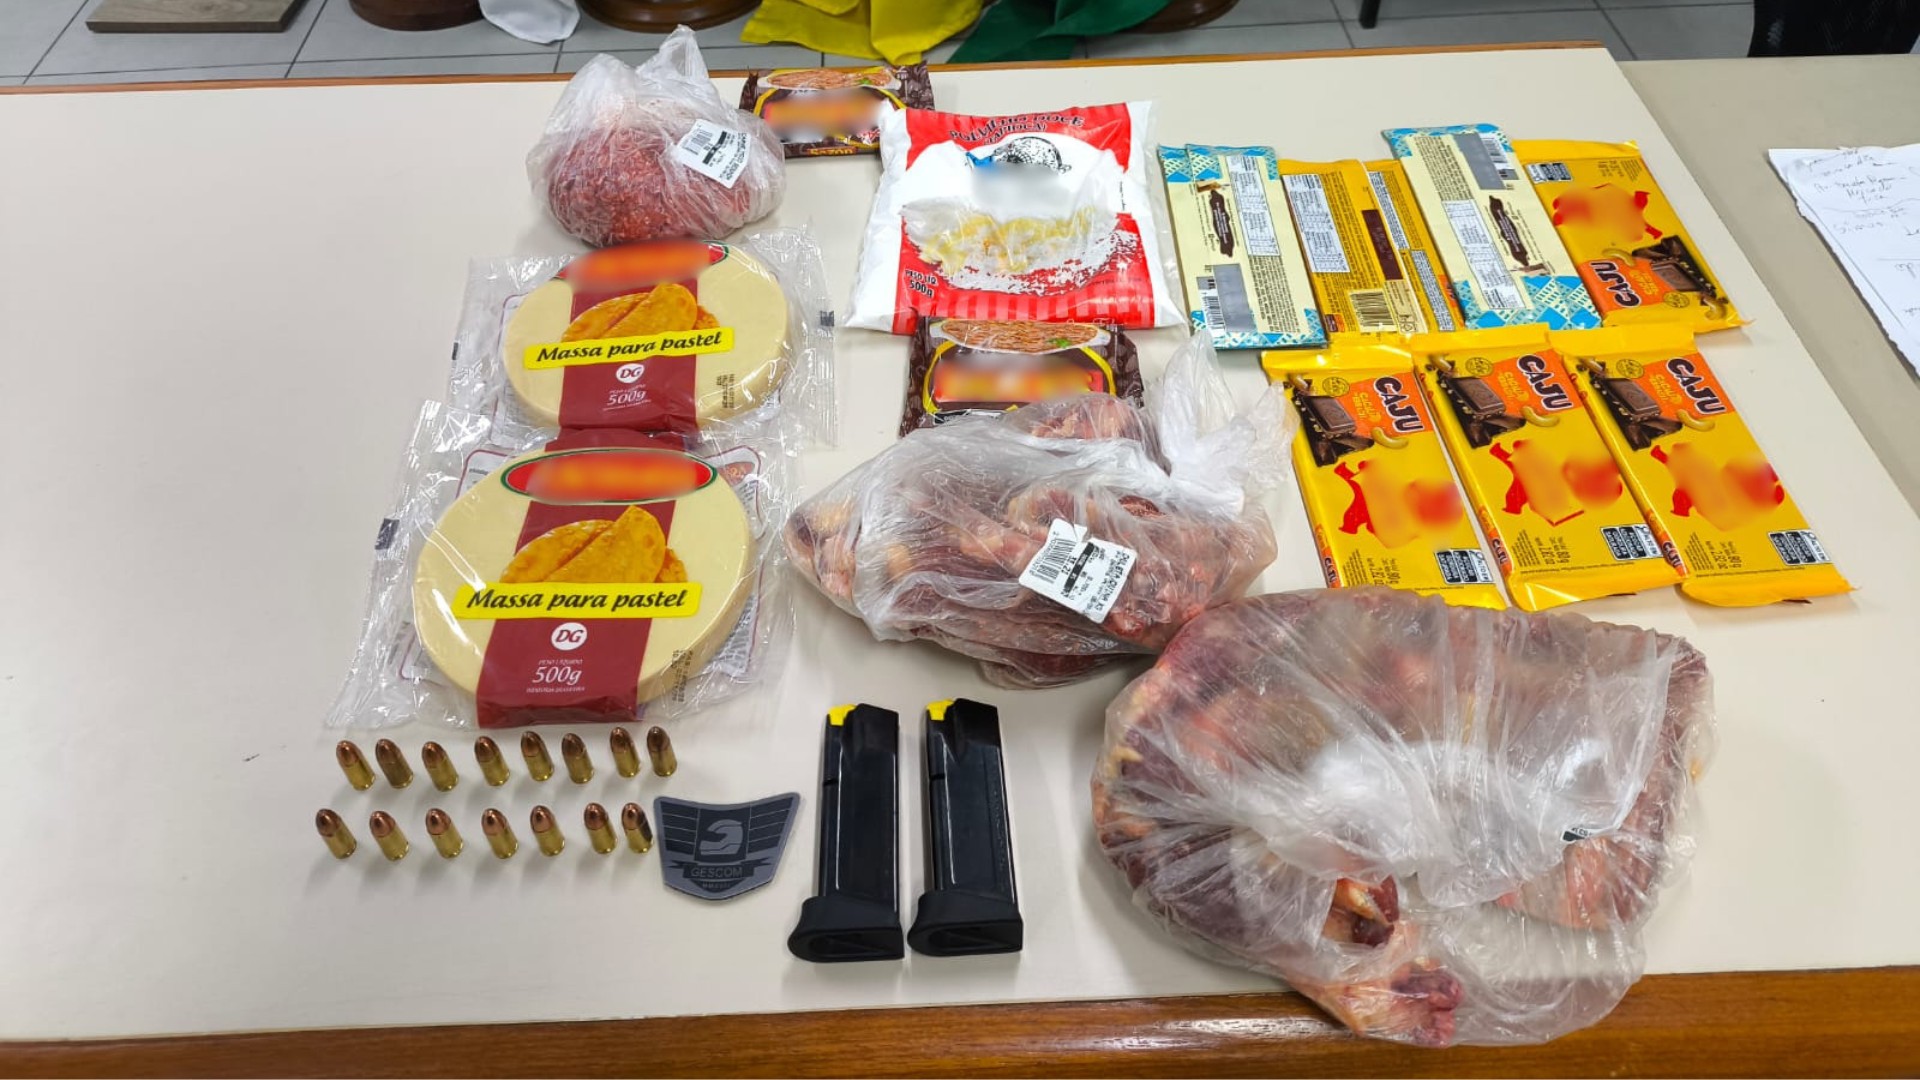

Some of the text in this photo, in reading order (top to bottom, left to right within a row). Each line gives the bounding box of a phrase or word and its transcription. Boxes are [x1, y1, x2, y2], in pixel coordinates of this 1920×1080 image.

[909, 279, 933, 298] 500g
[1589, 260, 1642, 309] CAJU
[536, 330, 723, 363] Massa para pastel
[619, 366, 641, 378] DG
[1517, 354, 1573, 411] CAJU
[606, 389, 646, 406] 500g
[1666, 357, 1726, 415] CAJU
[1373, 375, 1425, 433] CAJU
[466, 588, 687, 612] Massa para pastel
[554, 628, 583, 645] DG
[531, 664, 582, 687] 500g
[690, 866, 743, 878] GESCOM
